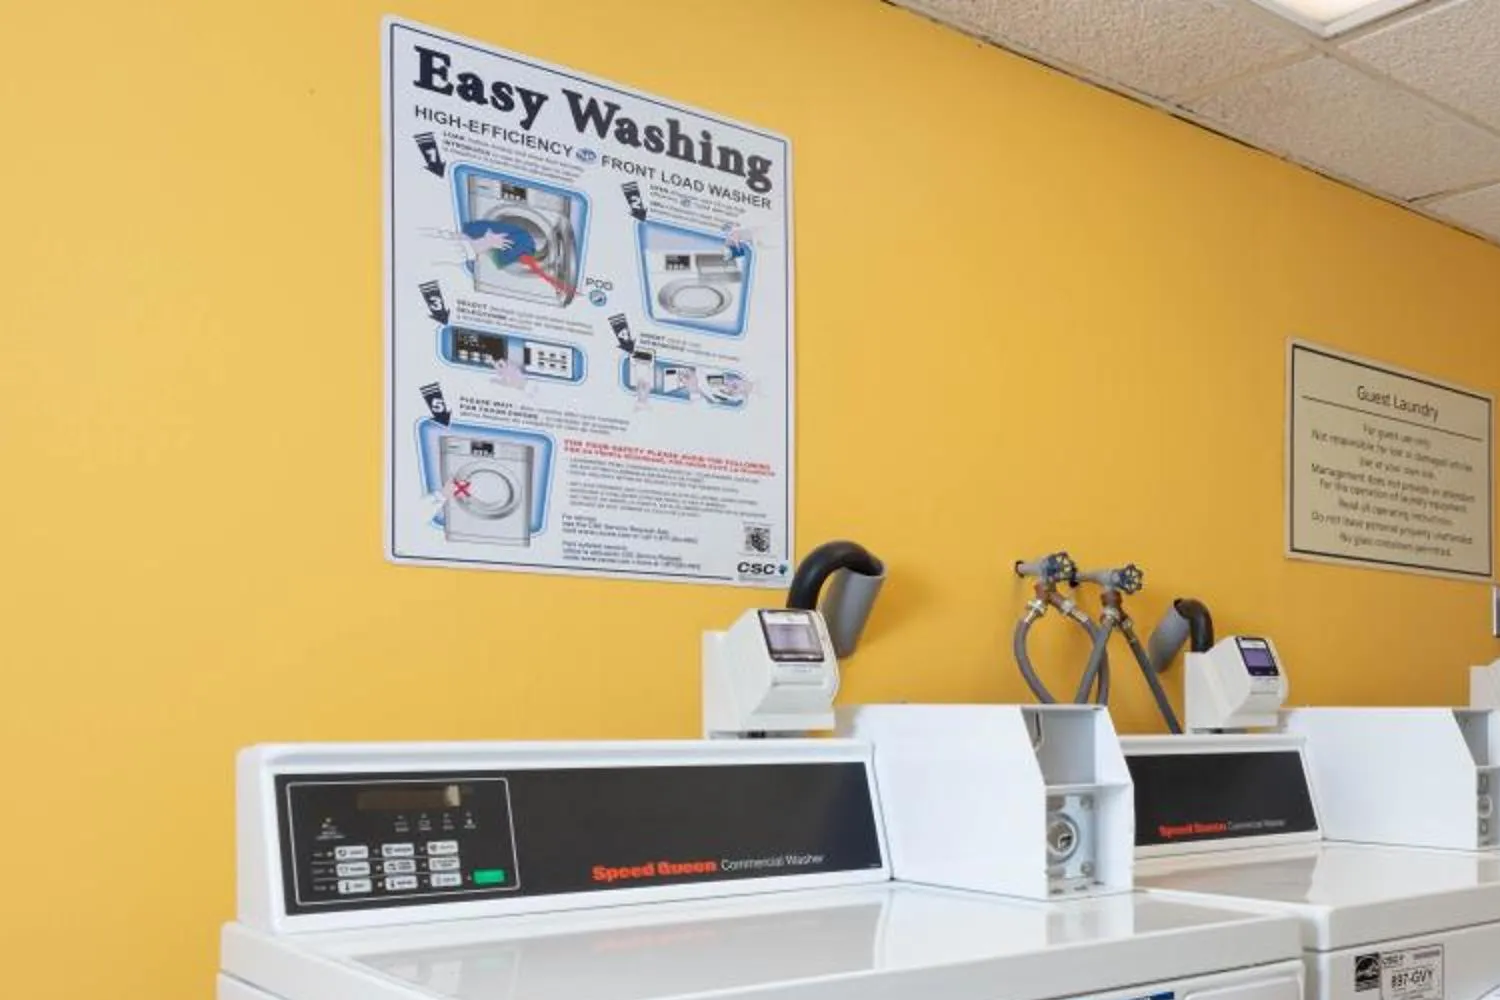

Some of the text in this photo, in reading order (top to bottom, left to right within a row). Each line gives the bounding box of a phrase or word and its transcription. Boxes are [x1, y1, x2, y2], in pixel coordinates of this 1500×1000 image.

[413, 45, 549, 130] Easy
[562, 88, 772, 194] Washing
[415, 105, 574, 158] HIGH-EFFICIENCY
[601, 155, 656, 180] FRONT
[661, 171, 705, 192] LOAD
[708, 183, 772, 210] WASHER
[431, 398, 445, 413] 5
[1357, 385, 1439, 423] Guest Laundry
[737, 561, 776, 575] CSC
[592, 853, 825, 883] Speed Queen Commercial Washer
